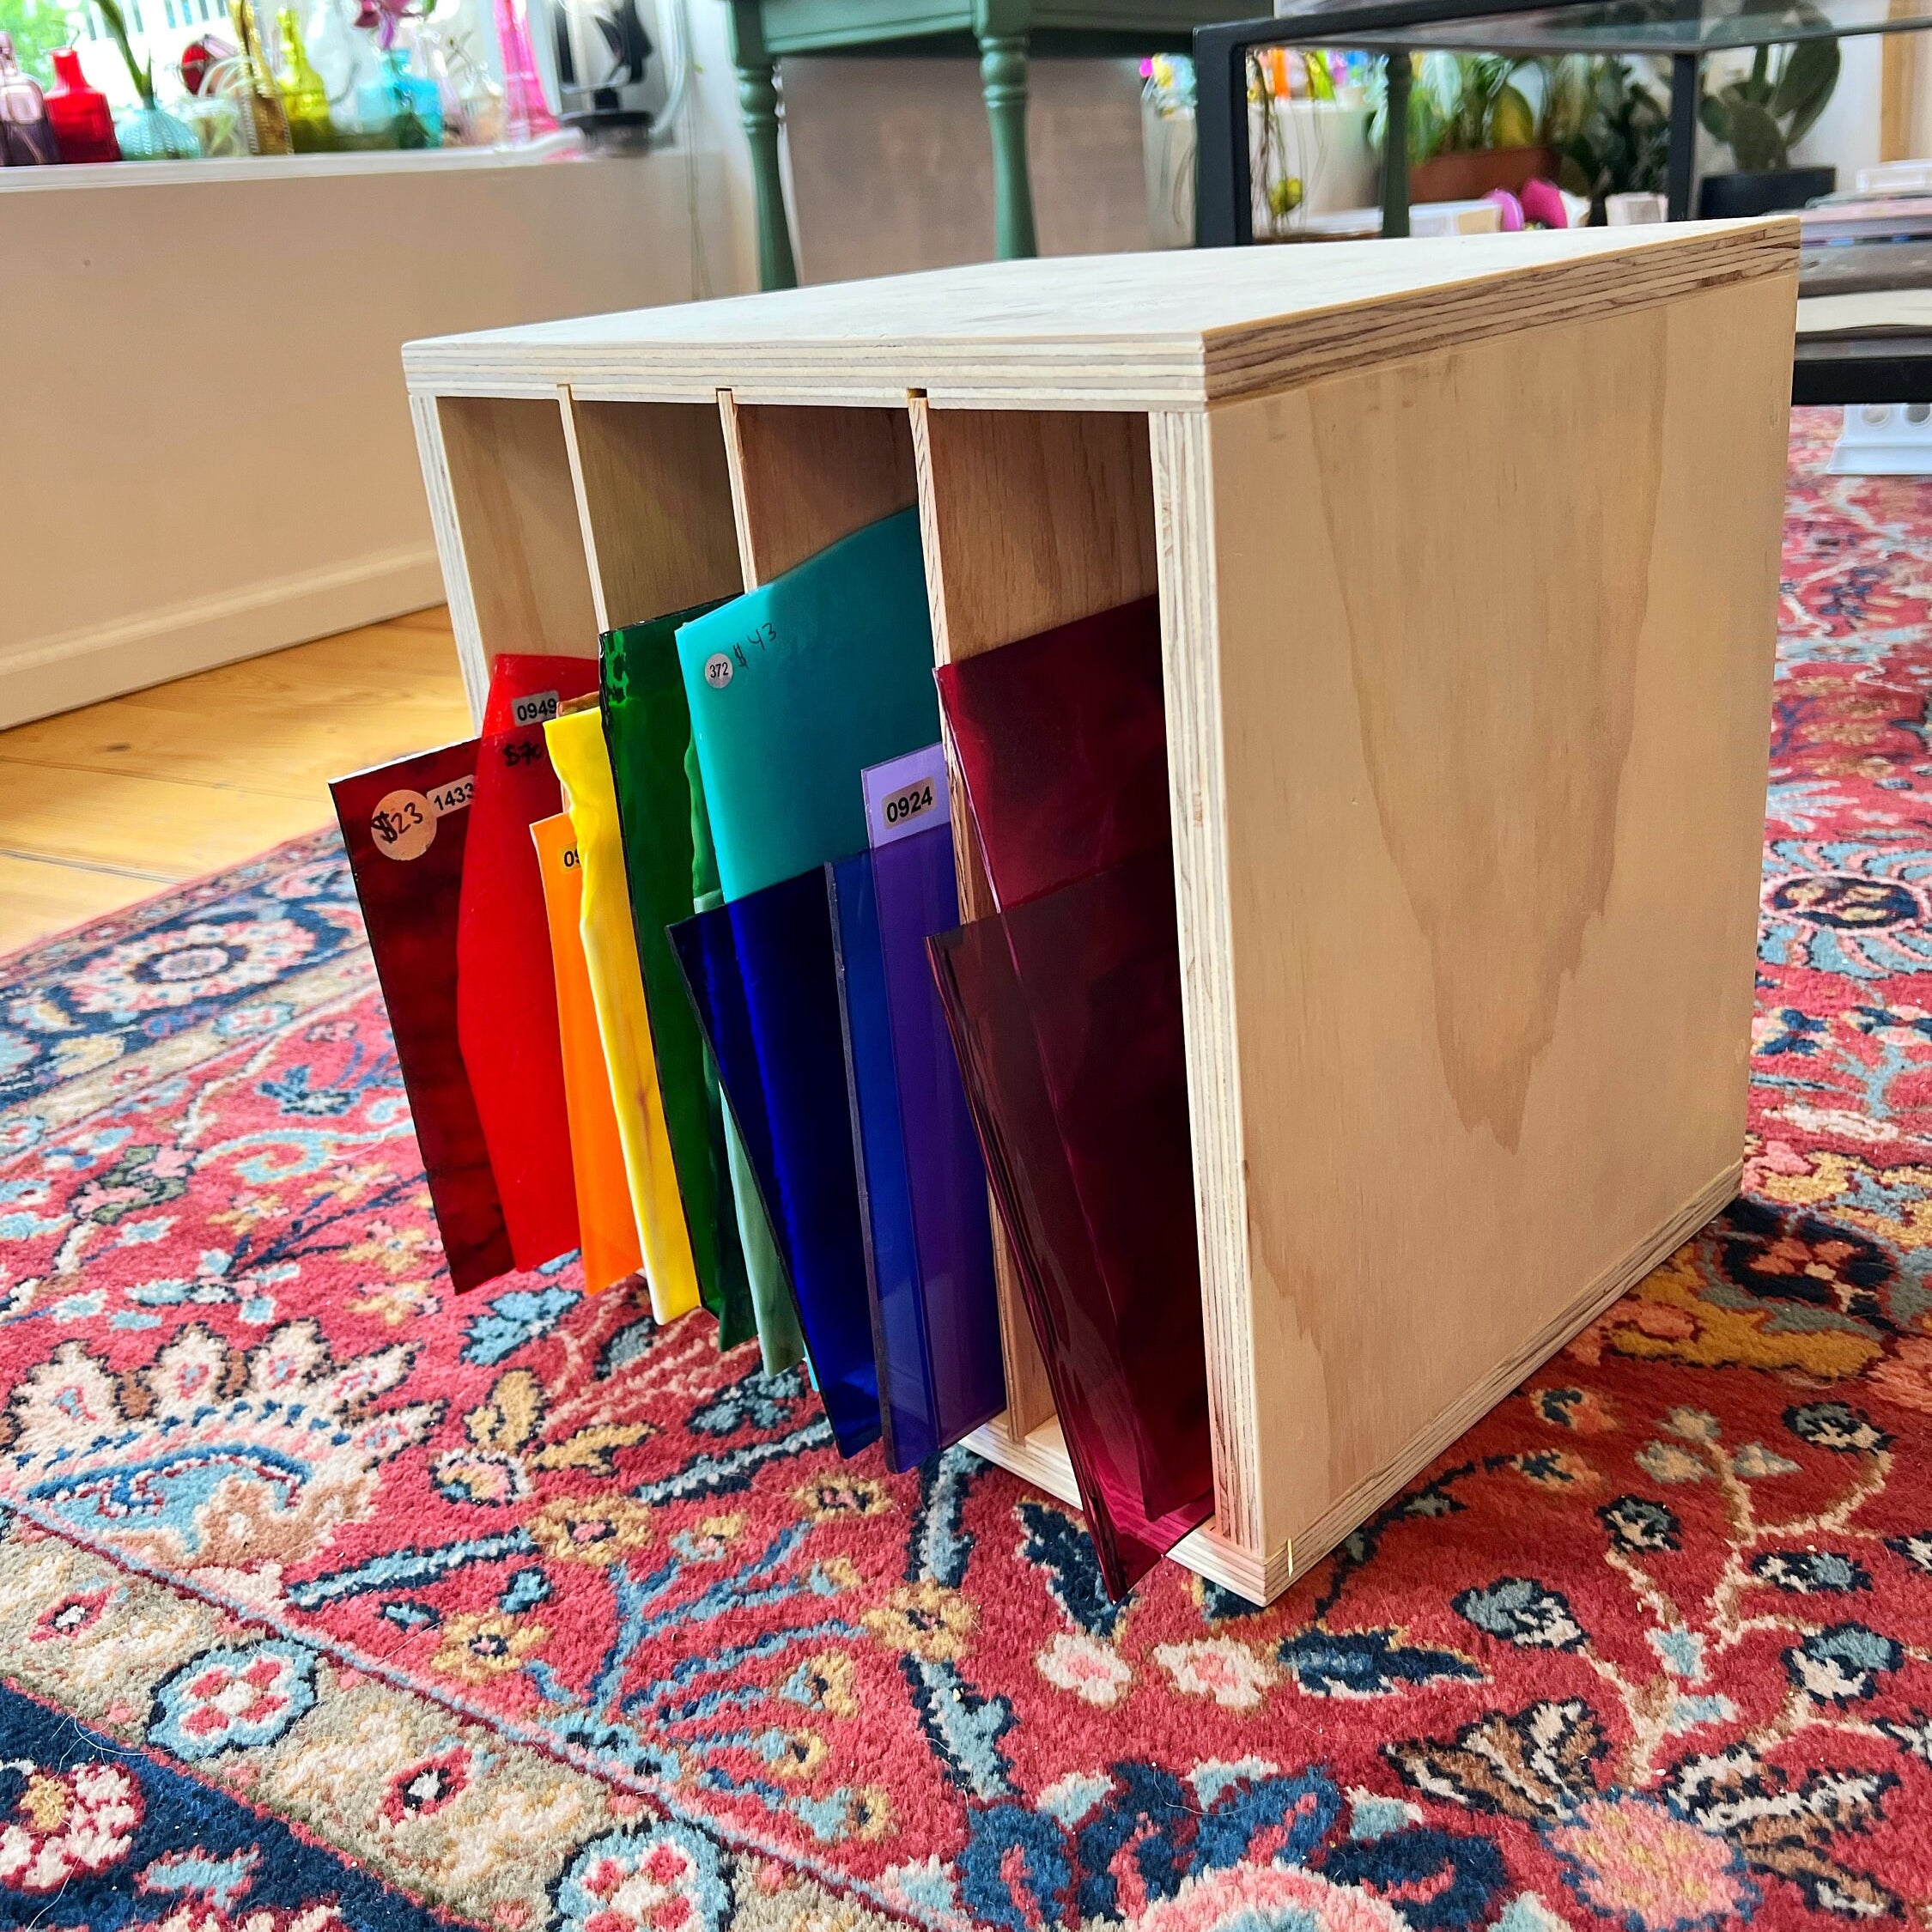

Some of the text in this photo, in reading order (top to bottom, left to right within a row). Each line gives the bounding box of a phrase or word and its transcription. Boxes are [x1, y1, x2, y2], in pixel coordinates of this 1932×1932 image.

[709, 661, 729, 678] 372
[517, 697, 557, 721] 0949
[434, 782, 474, 811] 1433
[886, 786, 933, 823] 0924
[370, 801, 423, 844] $23
